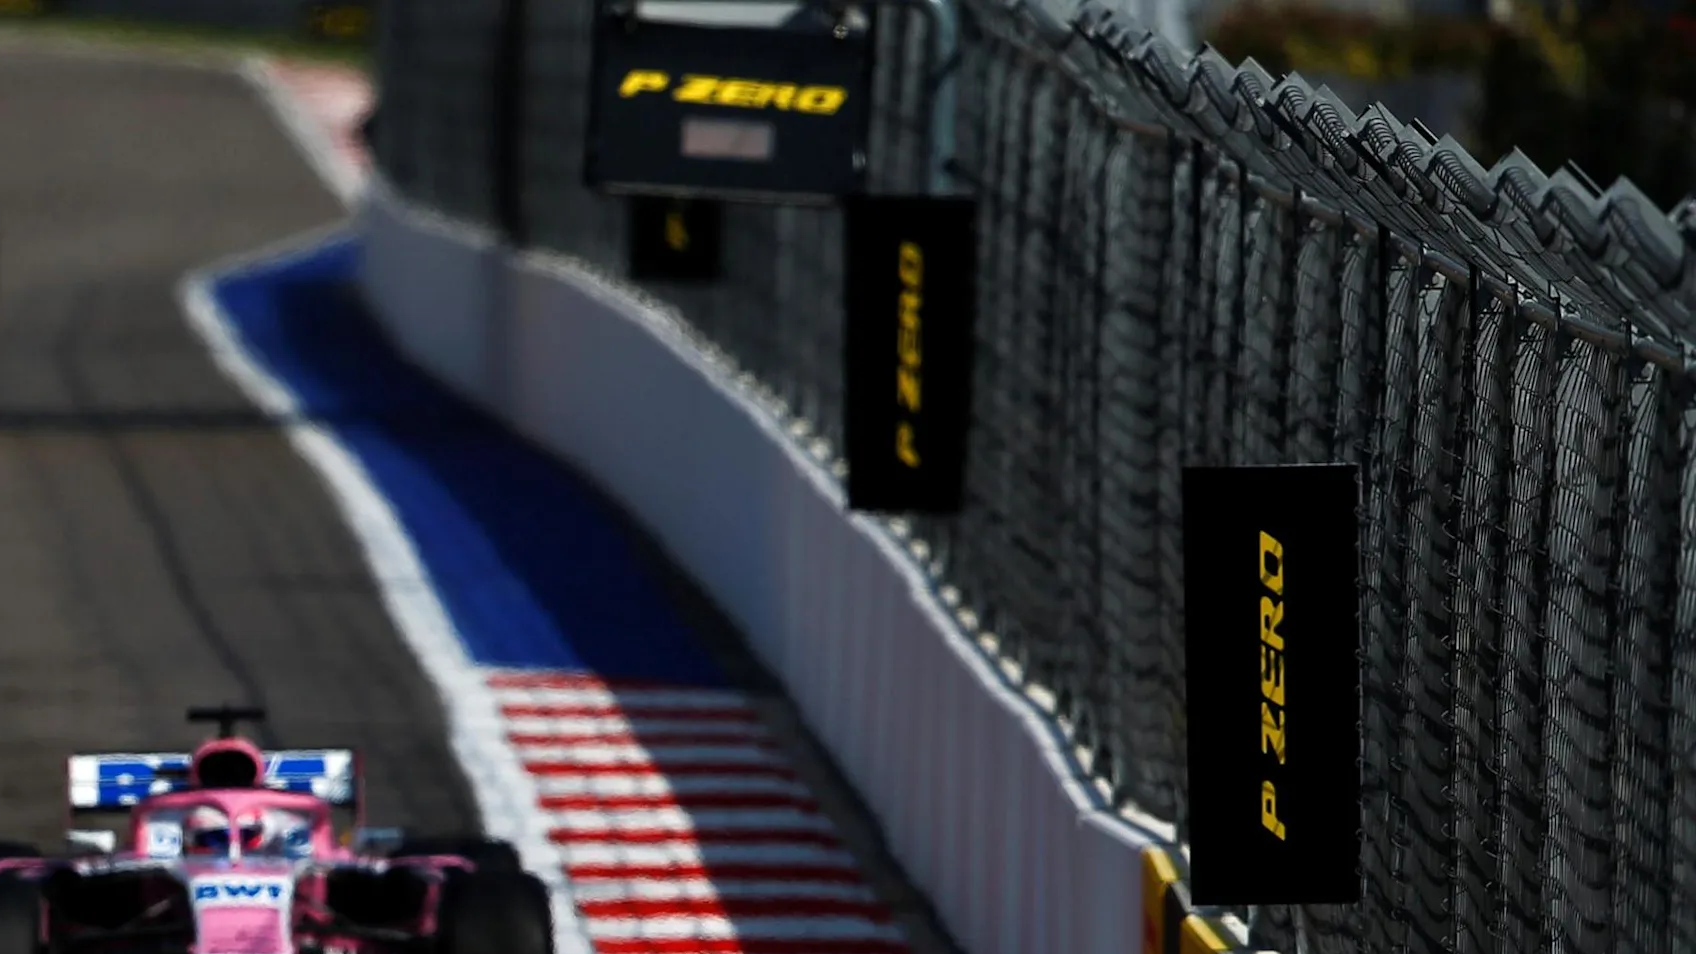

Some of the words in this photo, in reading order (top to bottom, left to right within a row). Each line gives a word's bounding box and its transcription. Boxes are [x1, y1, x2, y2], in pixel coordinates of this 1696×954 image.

[619, 70, 670, 98] P
[673, 74, 847, 115] ZERO
[896, 421, 921, 468] P
[1259, 530, 1286, 765] ZERO
[1261, 780, 1286, 841] P
